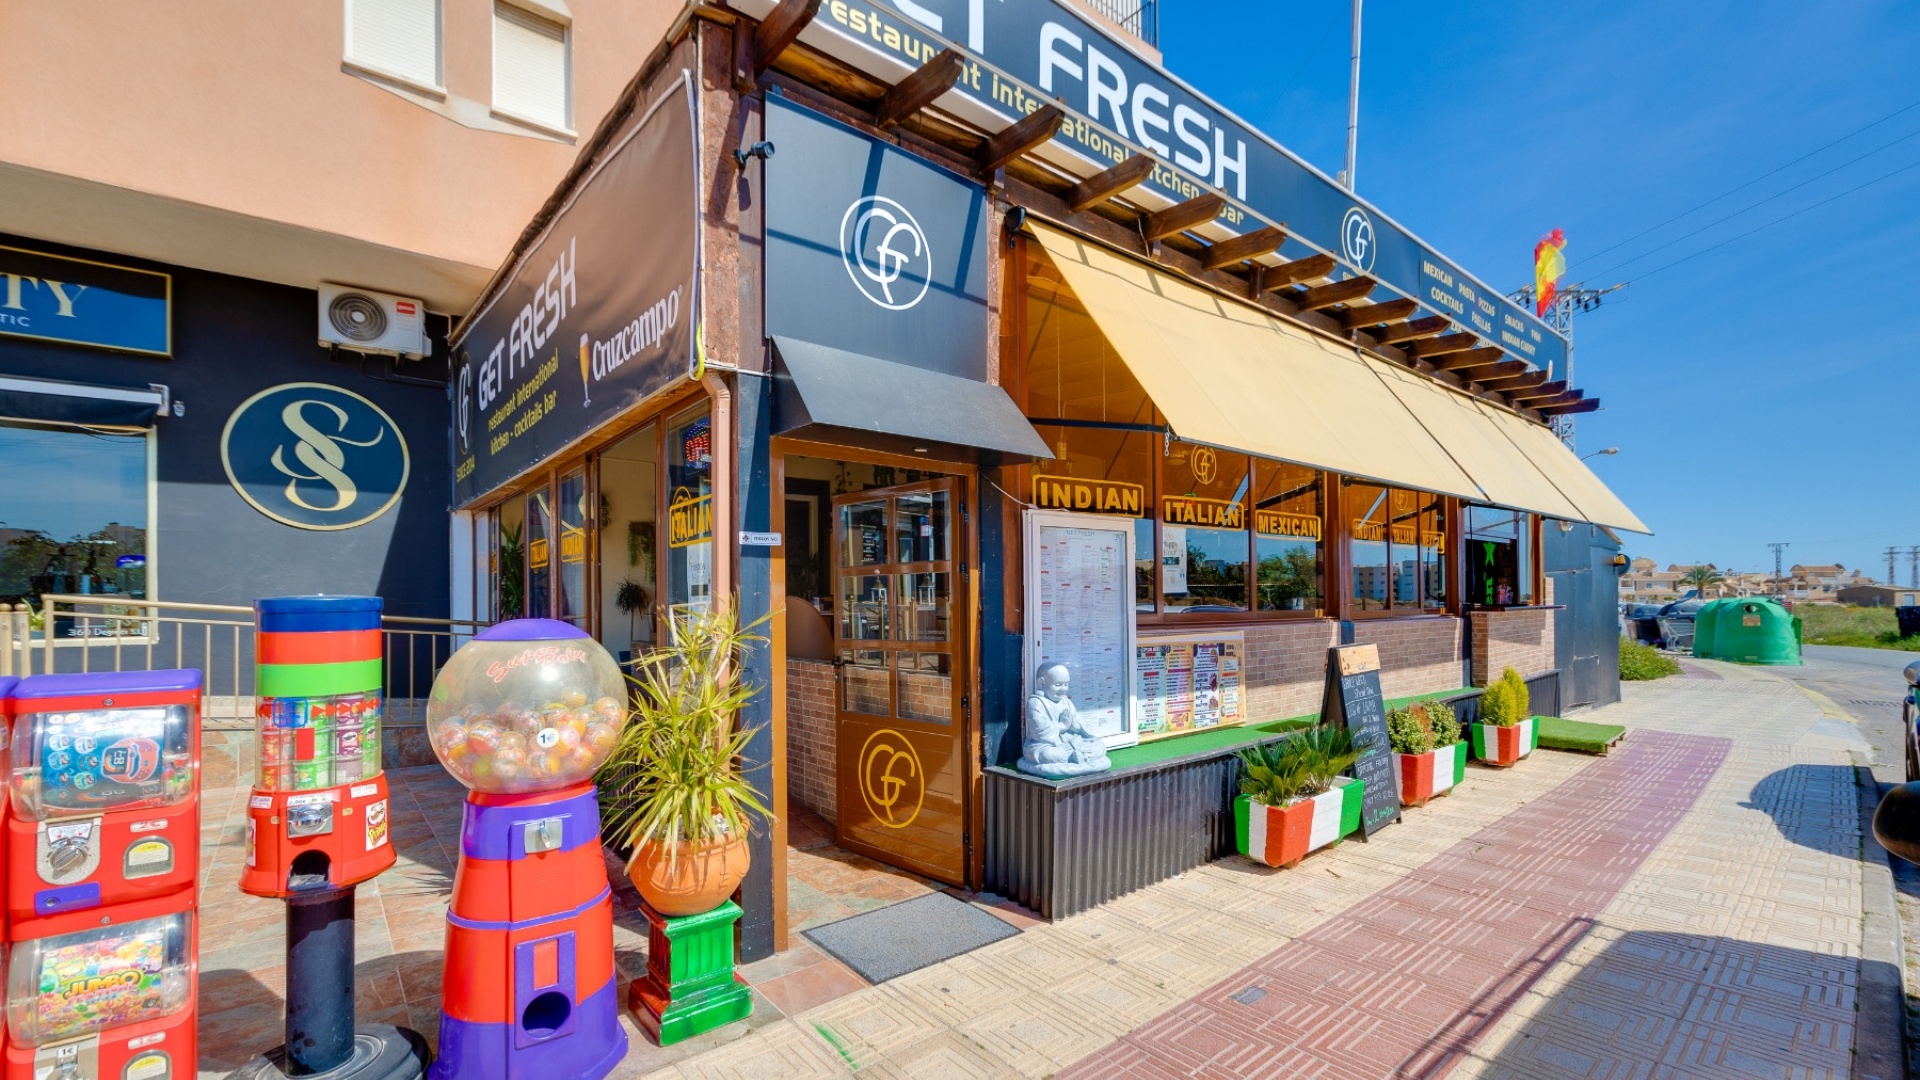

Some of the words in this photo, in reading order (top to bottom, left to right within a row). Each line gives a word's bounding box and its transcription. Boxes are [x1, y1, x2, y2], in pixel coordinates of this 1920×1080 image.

[817, 0, 981, 92] estaurnt
[992, 73, 1130, 164] inteational
[1149, 162, 1200, 200] itchen
[1039, 21, 1246, 202] FRESH
[478, 337, 506, 412] GET
[509, 235, 577, 380] FRESH
[1423, 260, 1453, 288] MEXICAN
[1458, 282, 1475, 303] PASTA
[1478, 297, 1495, 317] PIZZAS
[1504, 314, 1524, 333] SNACKS
[1431, 286, 1463, 315] COCKTAILS
[1502, 331, 1520, 348] INDIAN
[1520, 340, 1536, 356] CURRY
[592, 289, 679, 382] Cruzcampo
[488, 391, 517, 433] restaurant
[516, 347, 559, 410] international
[490, 431, 510, 457] kitchen
[514, 403, 543, 438] cocktails
[544, 390, 557, 415] bar
[1040, 481, 1139, 512] INDIAN
[1165, 501, 1239, 527] ITALIAN
[1258, 514, 1317, 537] MEXICAN
[1392, 527, 1414, 545] TALIAN
[63, 970, 141, 1000] JUMBO
